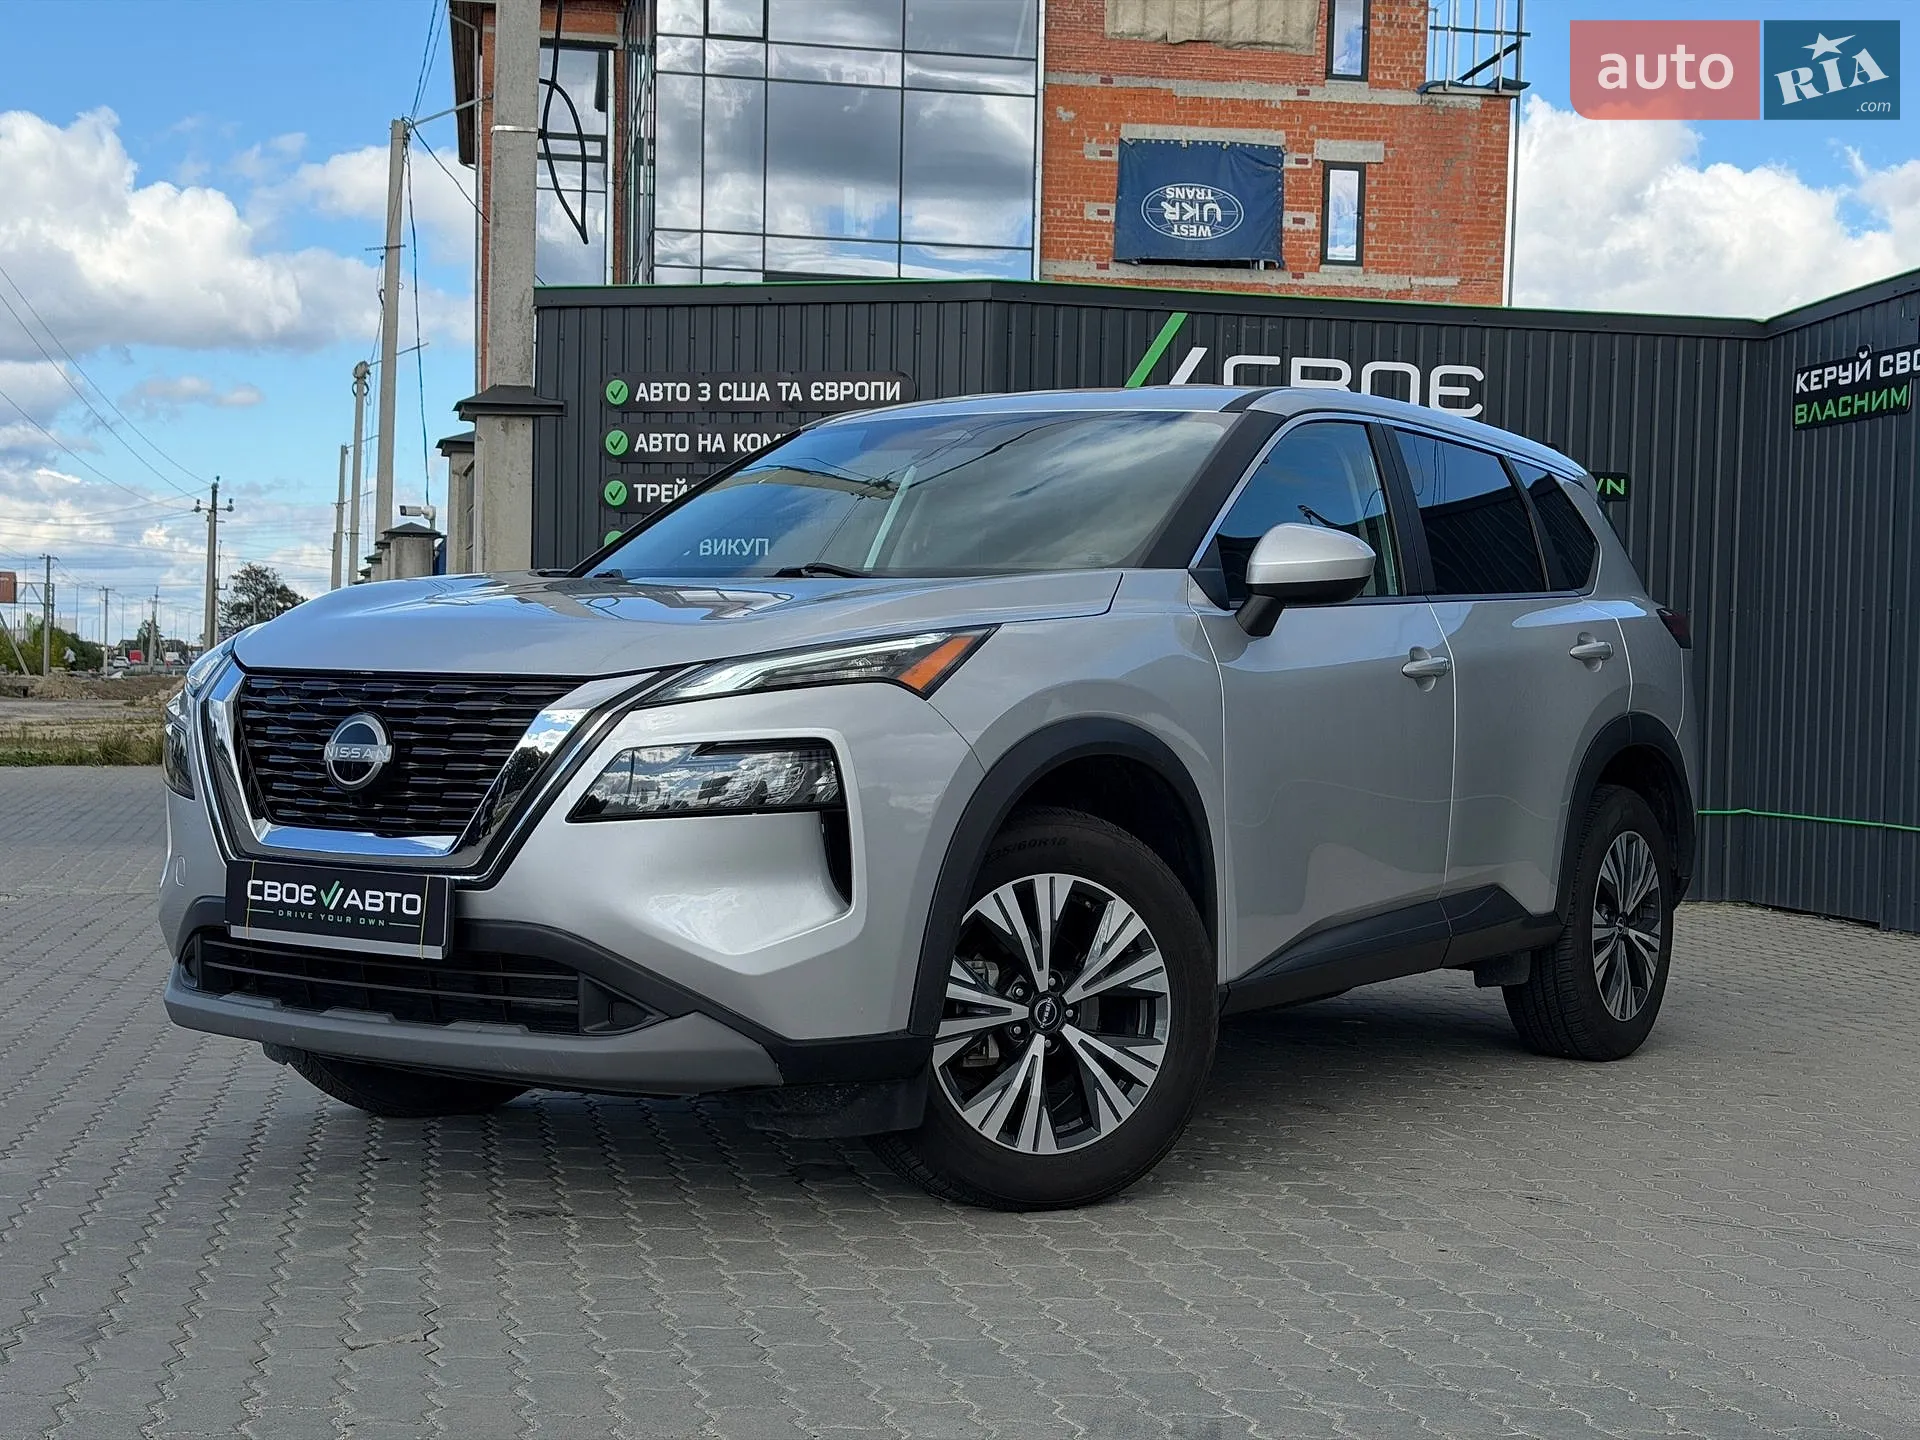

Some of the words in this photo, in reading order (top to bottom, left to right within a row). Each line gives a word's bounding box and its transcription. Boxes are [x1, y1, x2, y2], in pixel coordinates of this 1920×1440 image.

[1166, 187, 1214, 200] TRANS
[1160, 201, 1222, 223] UKR
[1172, 224, 1212, 238] WEST
[1795, 350, 1872, 394] КЕРУЙ
[635, 381, 691, 402] АВТО
[718, 381, 770, 402] США
[777, 381, 803, 402] ТА
[810, 381, 901, 402] ЄВРОПИ
[1795, 385, 1908, 425] ВЛАСНИМ
[634, 432, 689, 452] АВТО
[697, 433, 726, 453] НА
[633, 477, 696, 503] ТРЕЙ
[699, 538, 769, 556] ВИКУП
[325, 746, 389, 761] NISSAN
[246, 879, 317, 906] СВОЄ
[343, 888, 422, 915] АВТО
[278, 909, 314, 920] DRIVE
[320, 913, 352, 924] YOUR
[359, 917, 386, 927] OWN
